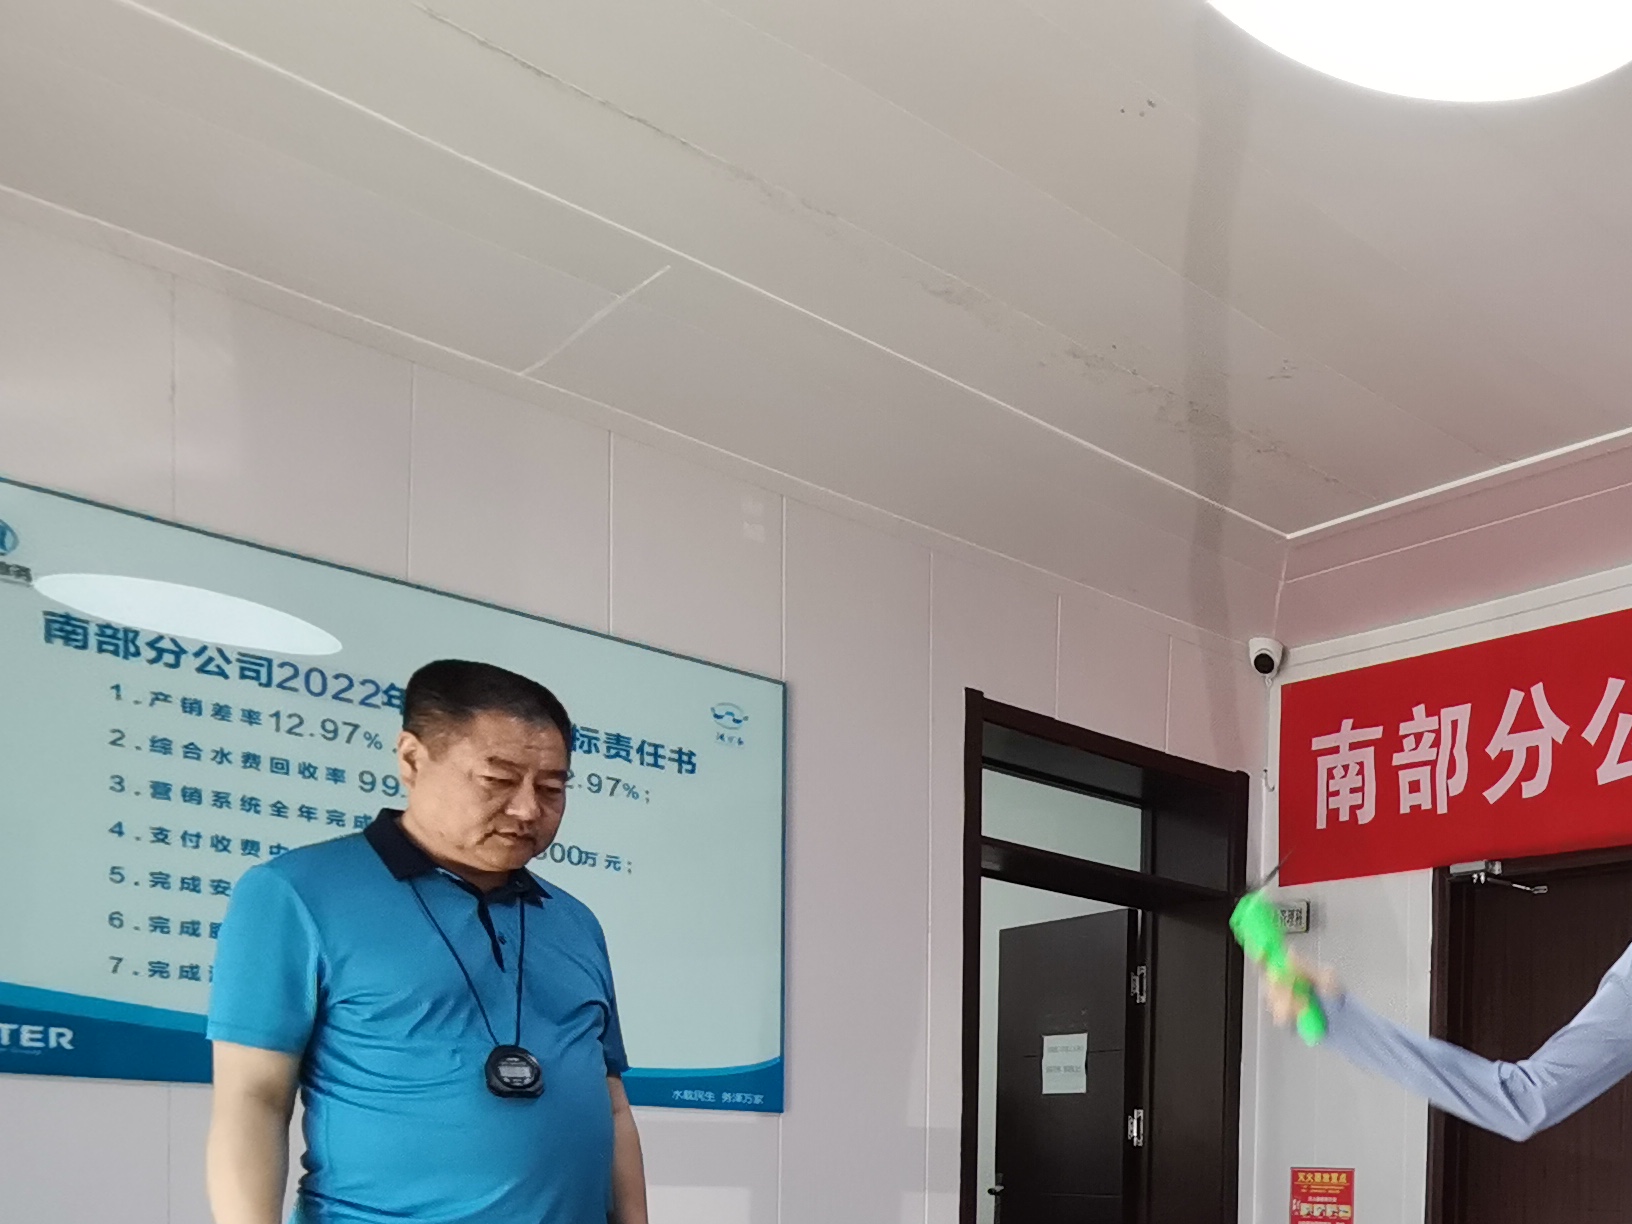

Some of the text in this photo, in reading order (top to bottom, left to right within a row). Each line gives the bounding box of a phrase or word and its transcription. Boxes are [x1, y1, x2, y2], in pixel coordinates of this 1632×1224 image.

[571, 724, 698, 775] 标责任书
[108, 955, 214, 983] 7.完成
